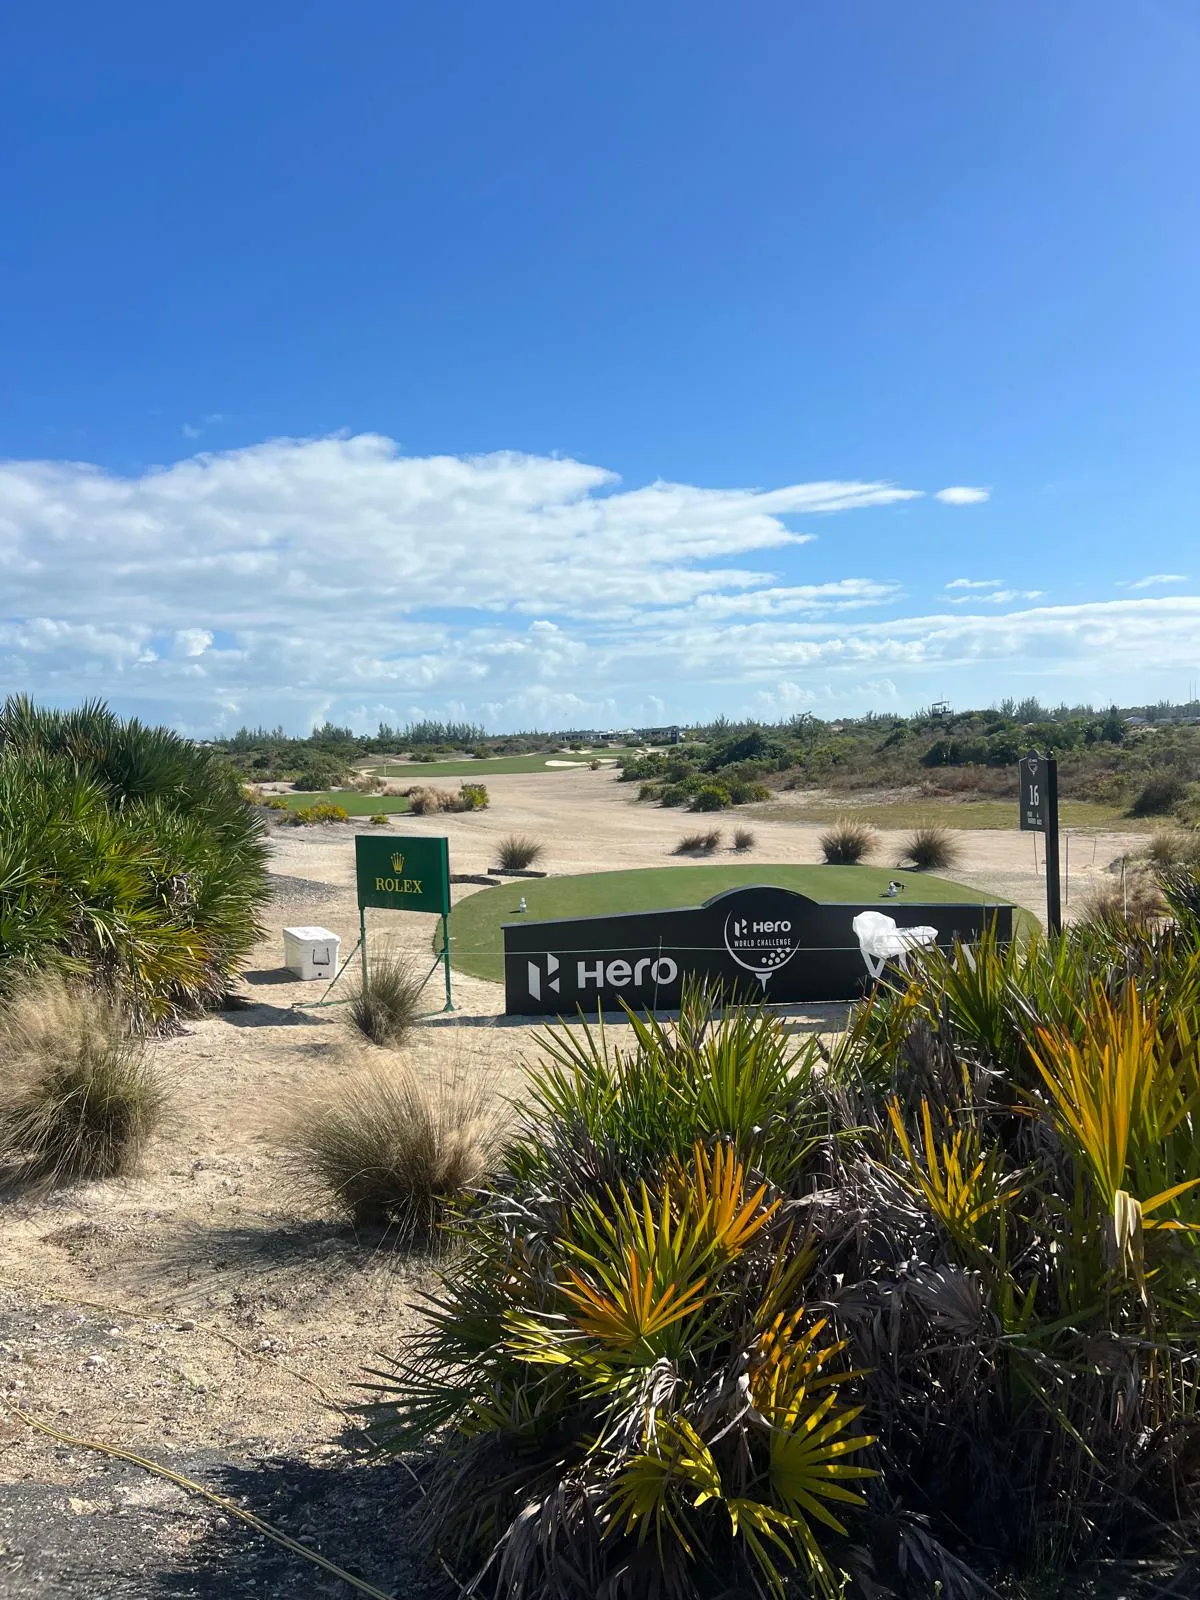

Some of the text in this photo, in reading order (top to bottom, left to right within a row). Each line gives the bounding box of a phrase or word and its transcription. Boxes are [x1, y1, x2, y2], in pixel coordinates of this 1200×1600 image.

[1029, 784, 1040, 806] 16
[375, 877, 423, 894] ROLEX
[753, 920, 792, 933] Hero
[734, 938, 792, 947] WORLD CHALLENGE
[577, 957, 678, 989] Hero
